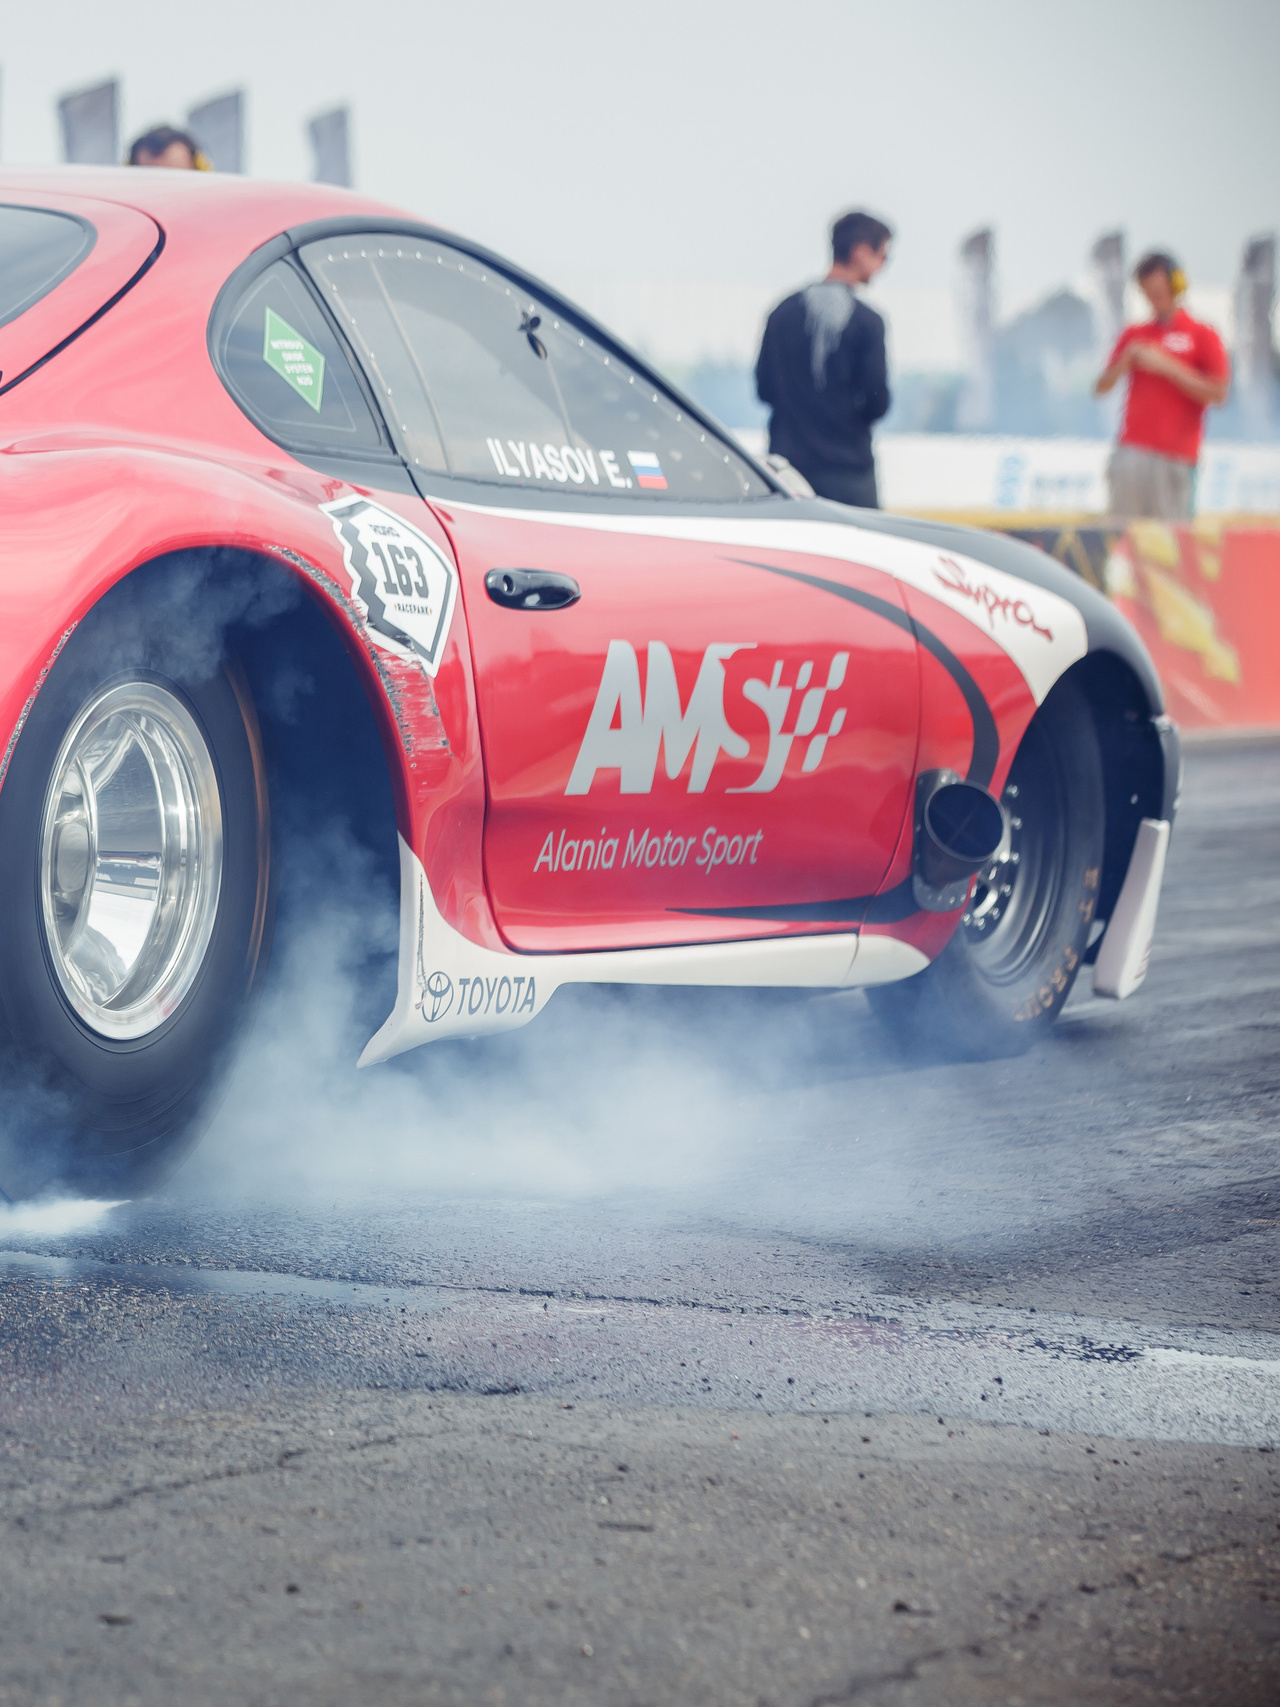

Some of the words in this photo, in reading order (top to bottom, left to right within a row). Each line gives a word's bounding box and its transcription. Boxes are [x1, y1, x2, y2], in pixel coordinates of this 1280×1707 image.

[284, 363, 314, 374] SYSTEM
[486, 437, 599, 486] ILYASOV
[598, 450, 633, 489] E.
[371, 541, 429, 599] 163
[397, 603, 430, 615] RACEPARK
[533, 826, 619, 872] Alania
[621, 827, 696, 869] Motor
[695, 826, 764, 876] Sport
[456, 975, 536, 1015] TOYOTA
